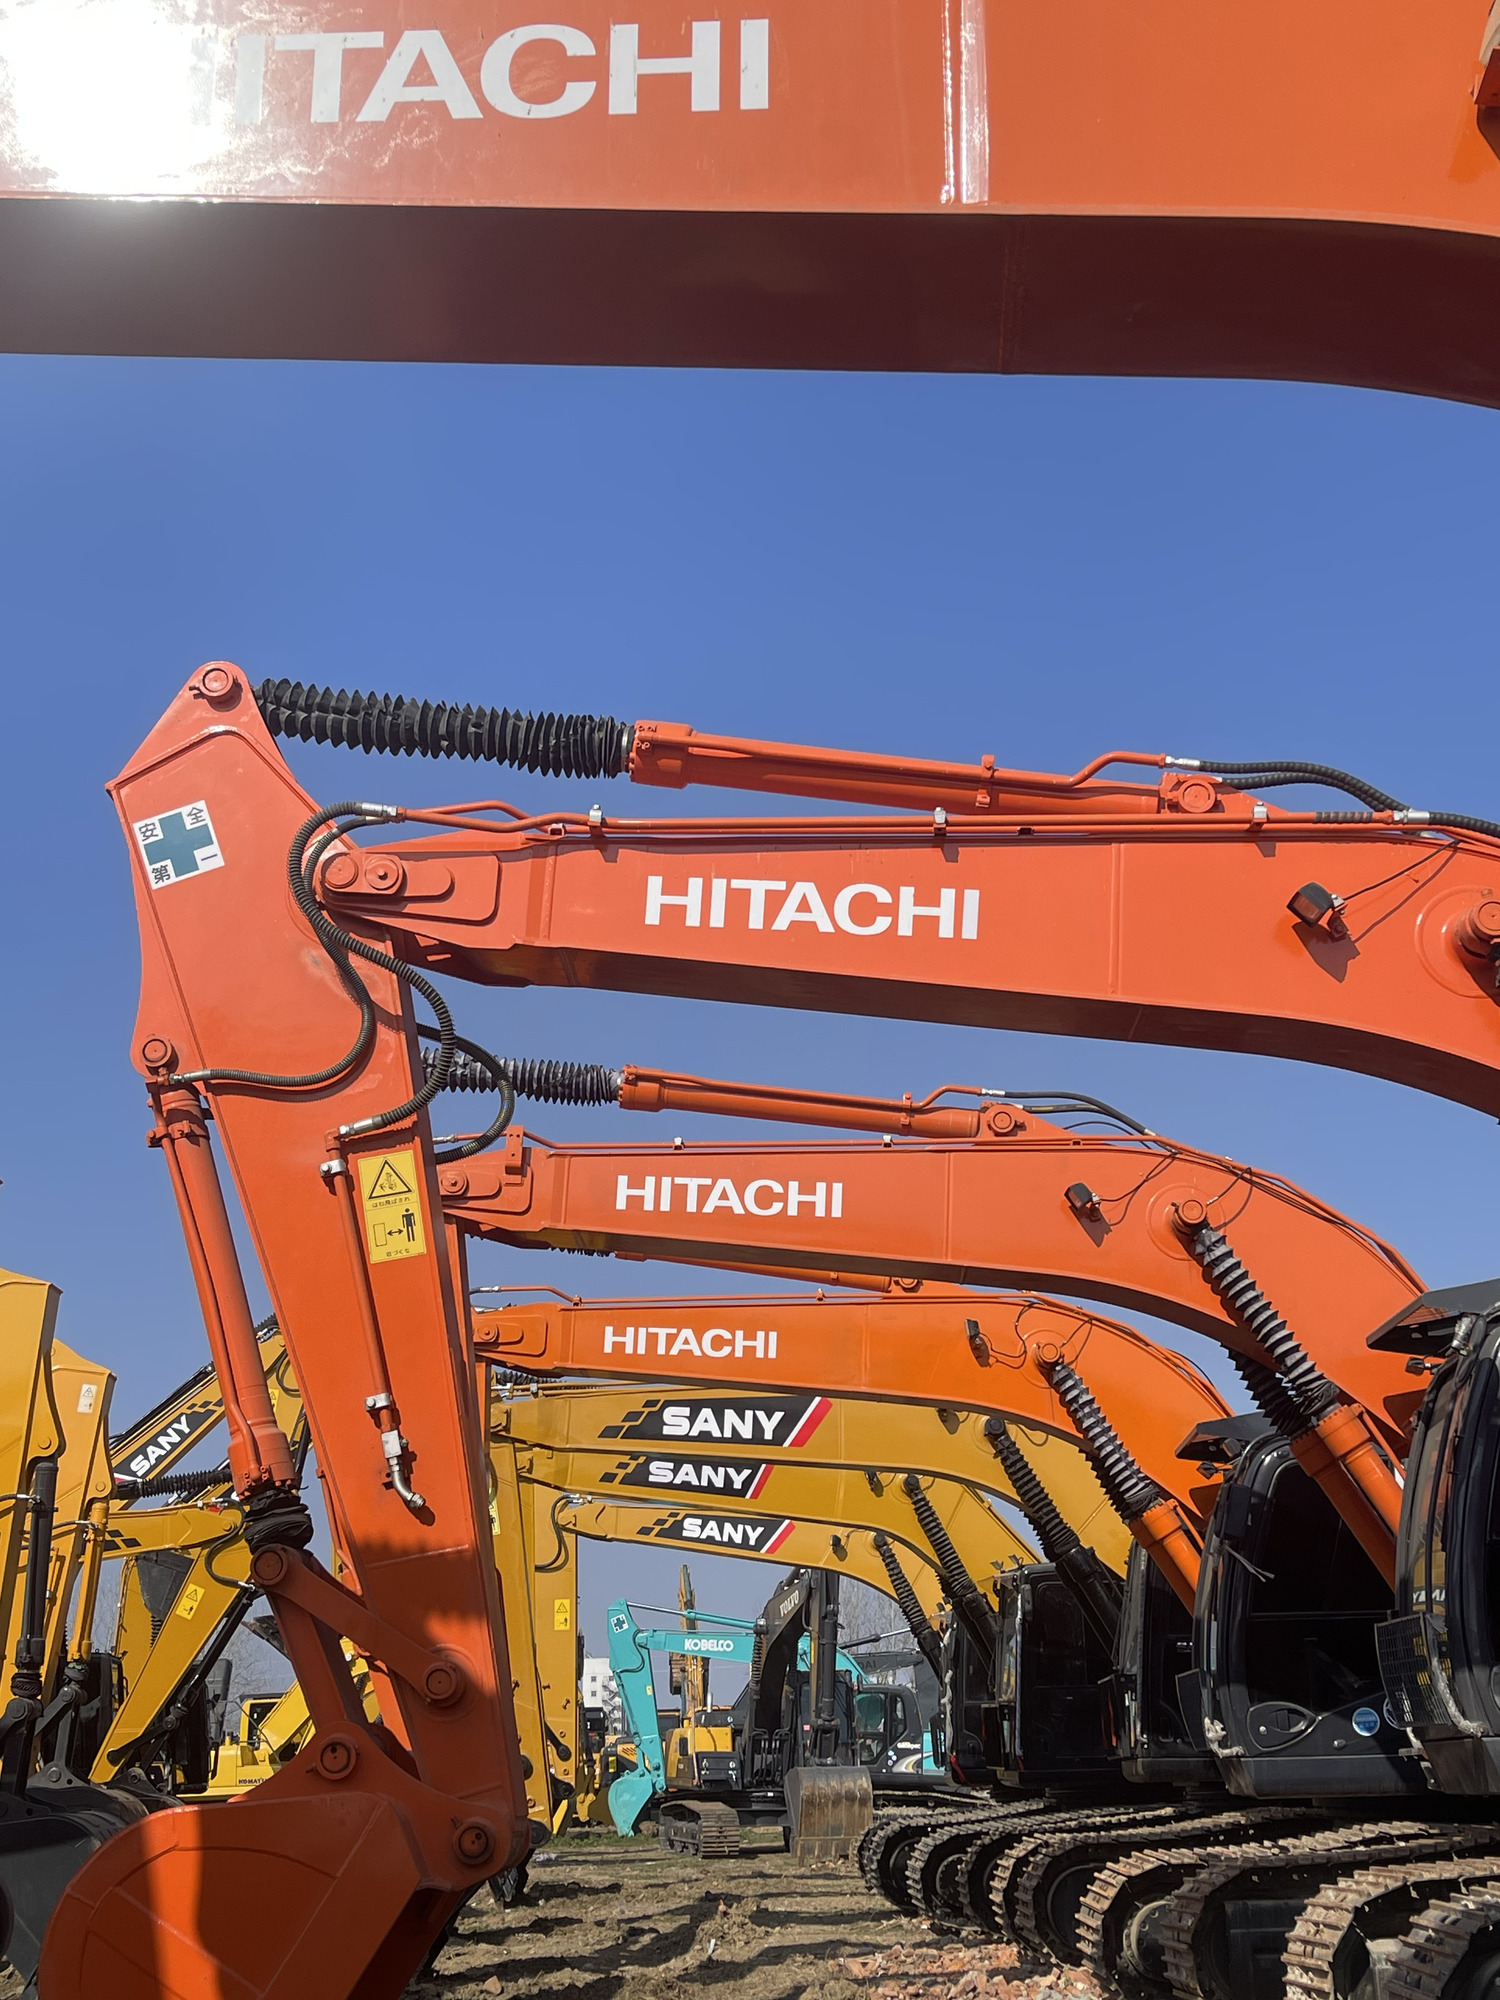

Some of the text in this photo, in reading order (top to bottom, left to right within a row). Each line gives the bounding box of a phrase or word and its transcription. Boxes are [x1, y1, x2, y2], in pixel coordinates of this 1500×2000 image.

[645, 875, 980, 940] HITACHI
[615, 1175, 843, 1218] HITACHI
[603, 1326, 778, 1359] HITACHI
[662, 1406, 785, 1440] SANY
[129, 1414, 191, 1477] SANY
[648, 1461, 752, 1489] SANY
[682, 1517, 765, 1545] SANY
[779, 1589, 799, 1617] VOLVO
[684, 1638, 734, 1652] KOBELCO
